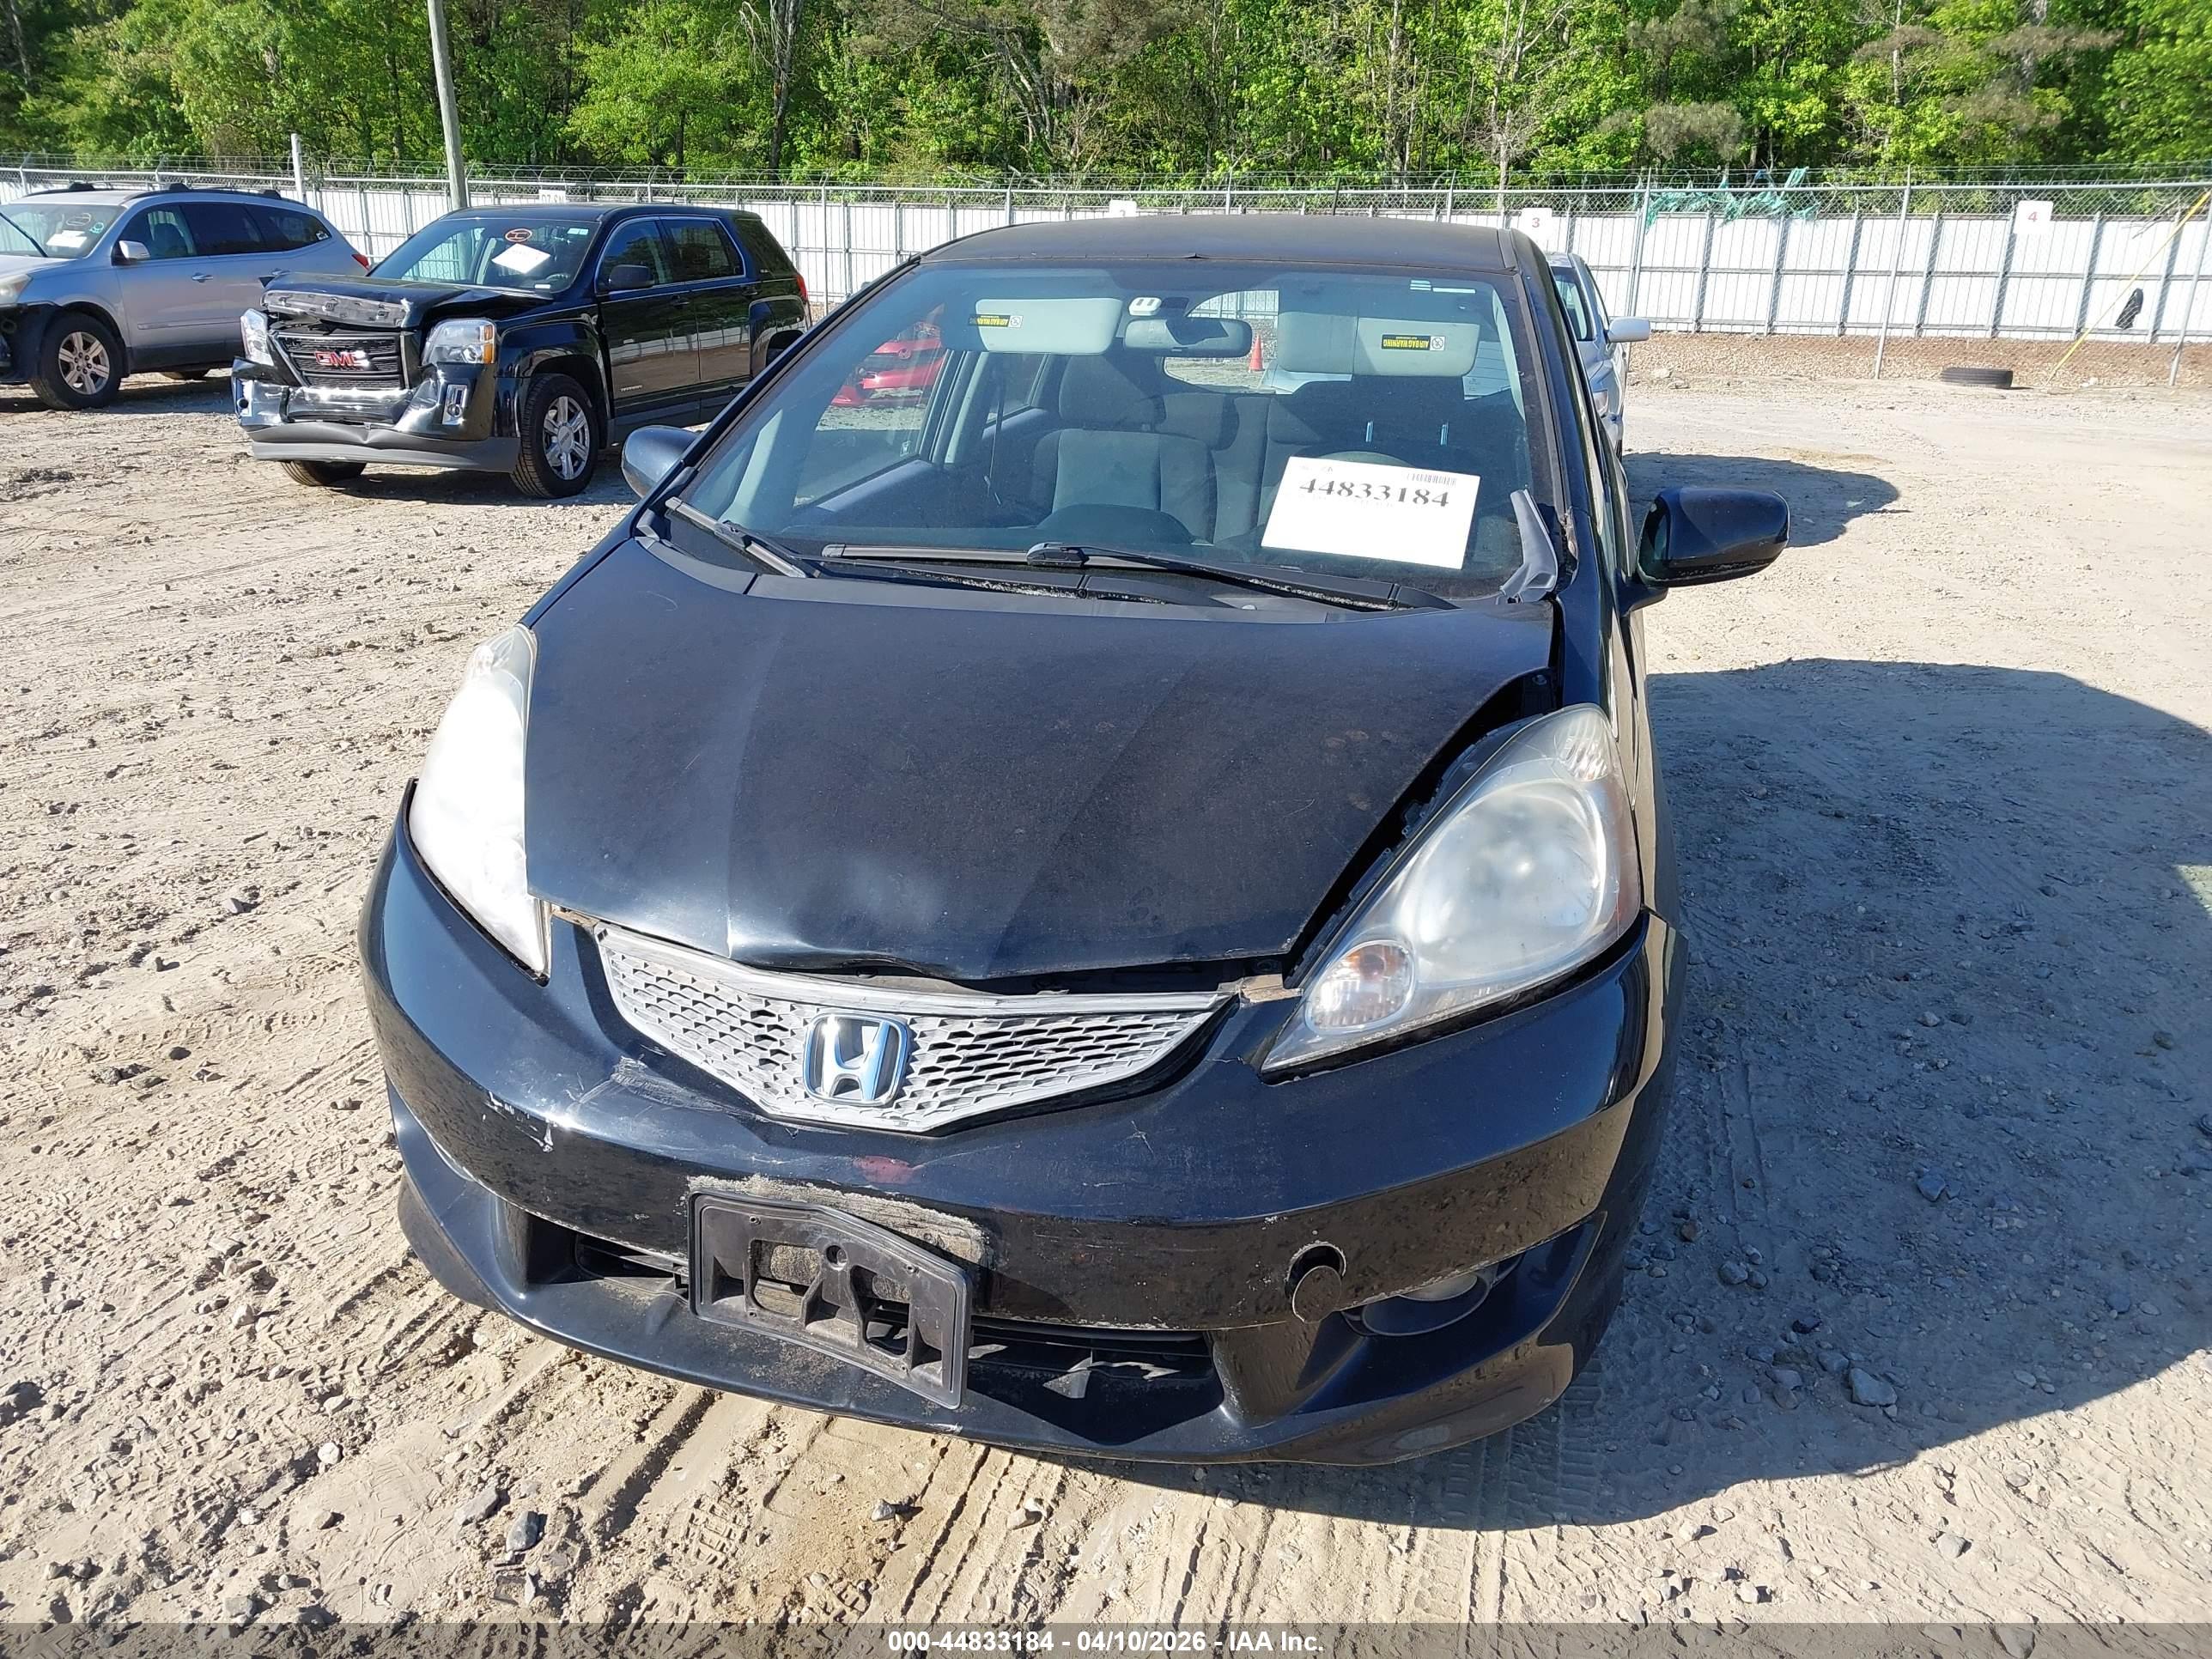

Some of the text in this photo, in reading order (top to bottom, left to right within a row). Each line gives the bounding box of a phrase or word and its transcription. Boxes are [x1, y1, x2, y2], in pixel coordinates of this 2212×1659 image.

[1531, 217, 1540, 228] 3
[2027, 211, 2039, 222] 4
[313, 349, 368, 368] GMC
[1299, 477, 1449, 507] 44833184
